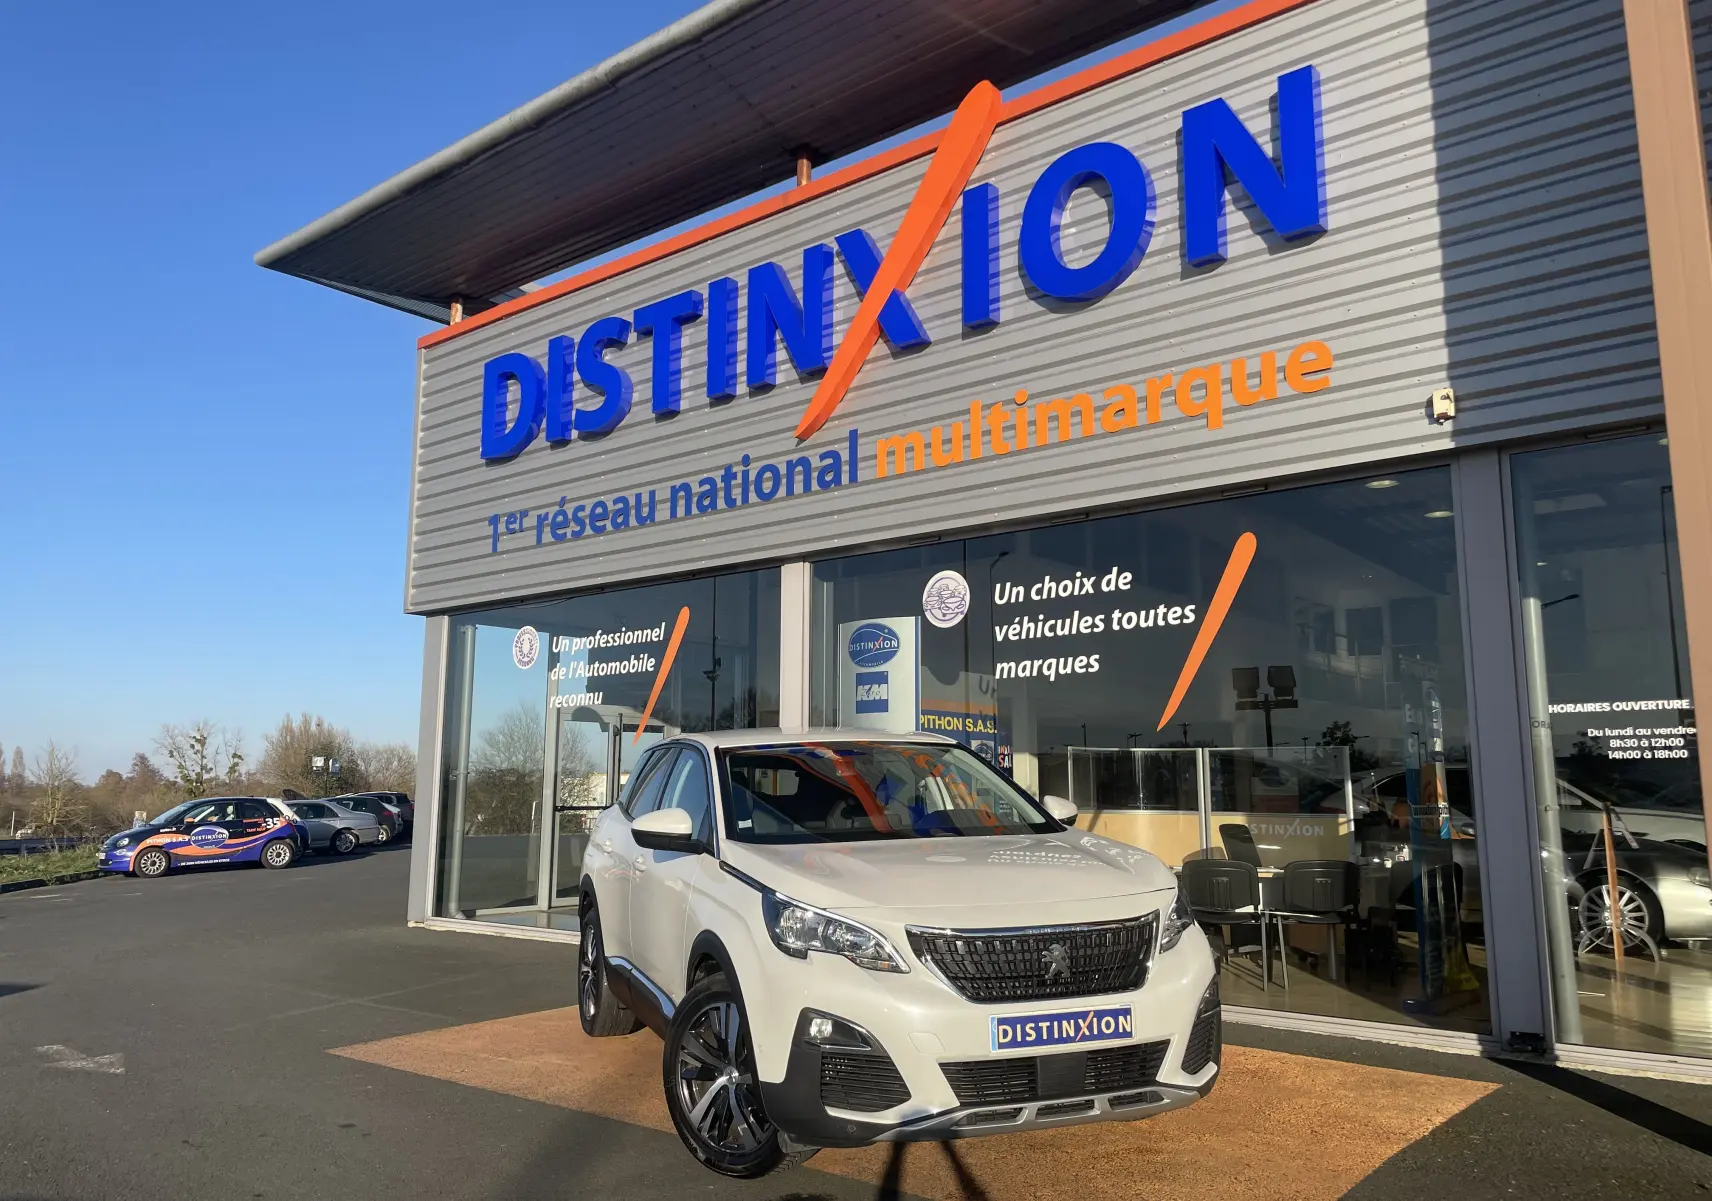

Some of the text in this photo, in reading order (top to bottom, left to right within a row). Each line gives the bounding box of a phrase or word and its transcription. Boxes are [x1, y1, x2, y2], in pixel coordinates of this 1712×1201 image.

[480, 65, 1328, 461] DISTINXION
[487, 340, 1334, 553] 1er réseau national multimarque
[994, 566, 1133, 605] Un choix de
[994, 603, 1196, 642] véhicules toutes
[552, 621, 666, 655] Un professionnel
[849, 636, 898, 652] DISTINXION
[550, 653, 656, 681] de l'Automobile
[994, 653, 1101, 682] marques
[549, 690, 604, 708] reconnu
[1548, 699, 1690, 713] HORAIRES OUVERTURE
[965, 718, 998, 734] S.A.S.
[1587, 728, 1602, 737] Du
[1605, 726, 1634, 737] lundi
[1635, 728, 1651, 736] au
[1607, 749, 1688, 760] 14h00 à 18h00
[1610, 737, 1684, 748] 8h30 à 12h00
[1250, 818, 1324, 838] STINXION
[998, 1010, 1132, 1043] DISTINXION
